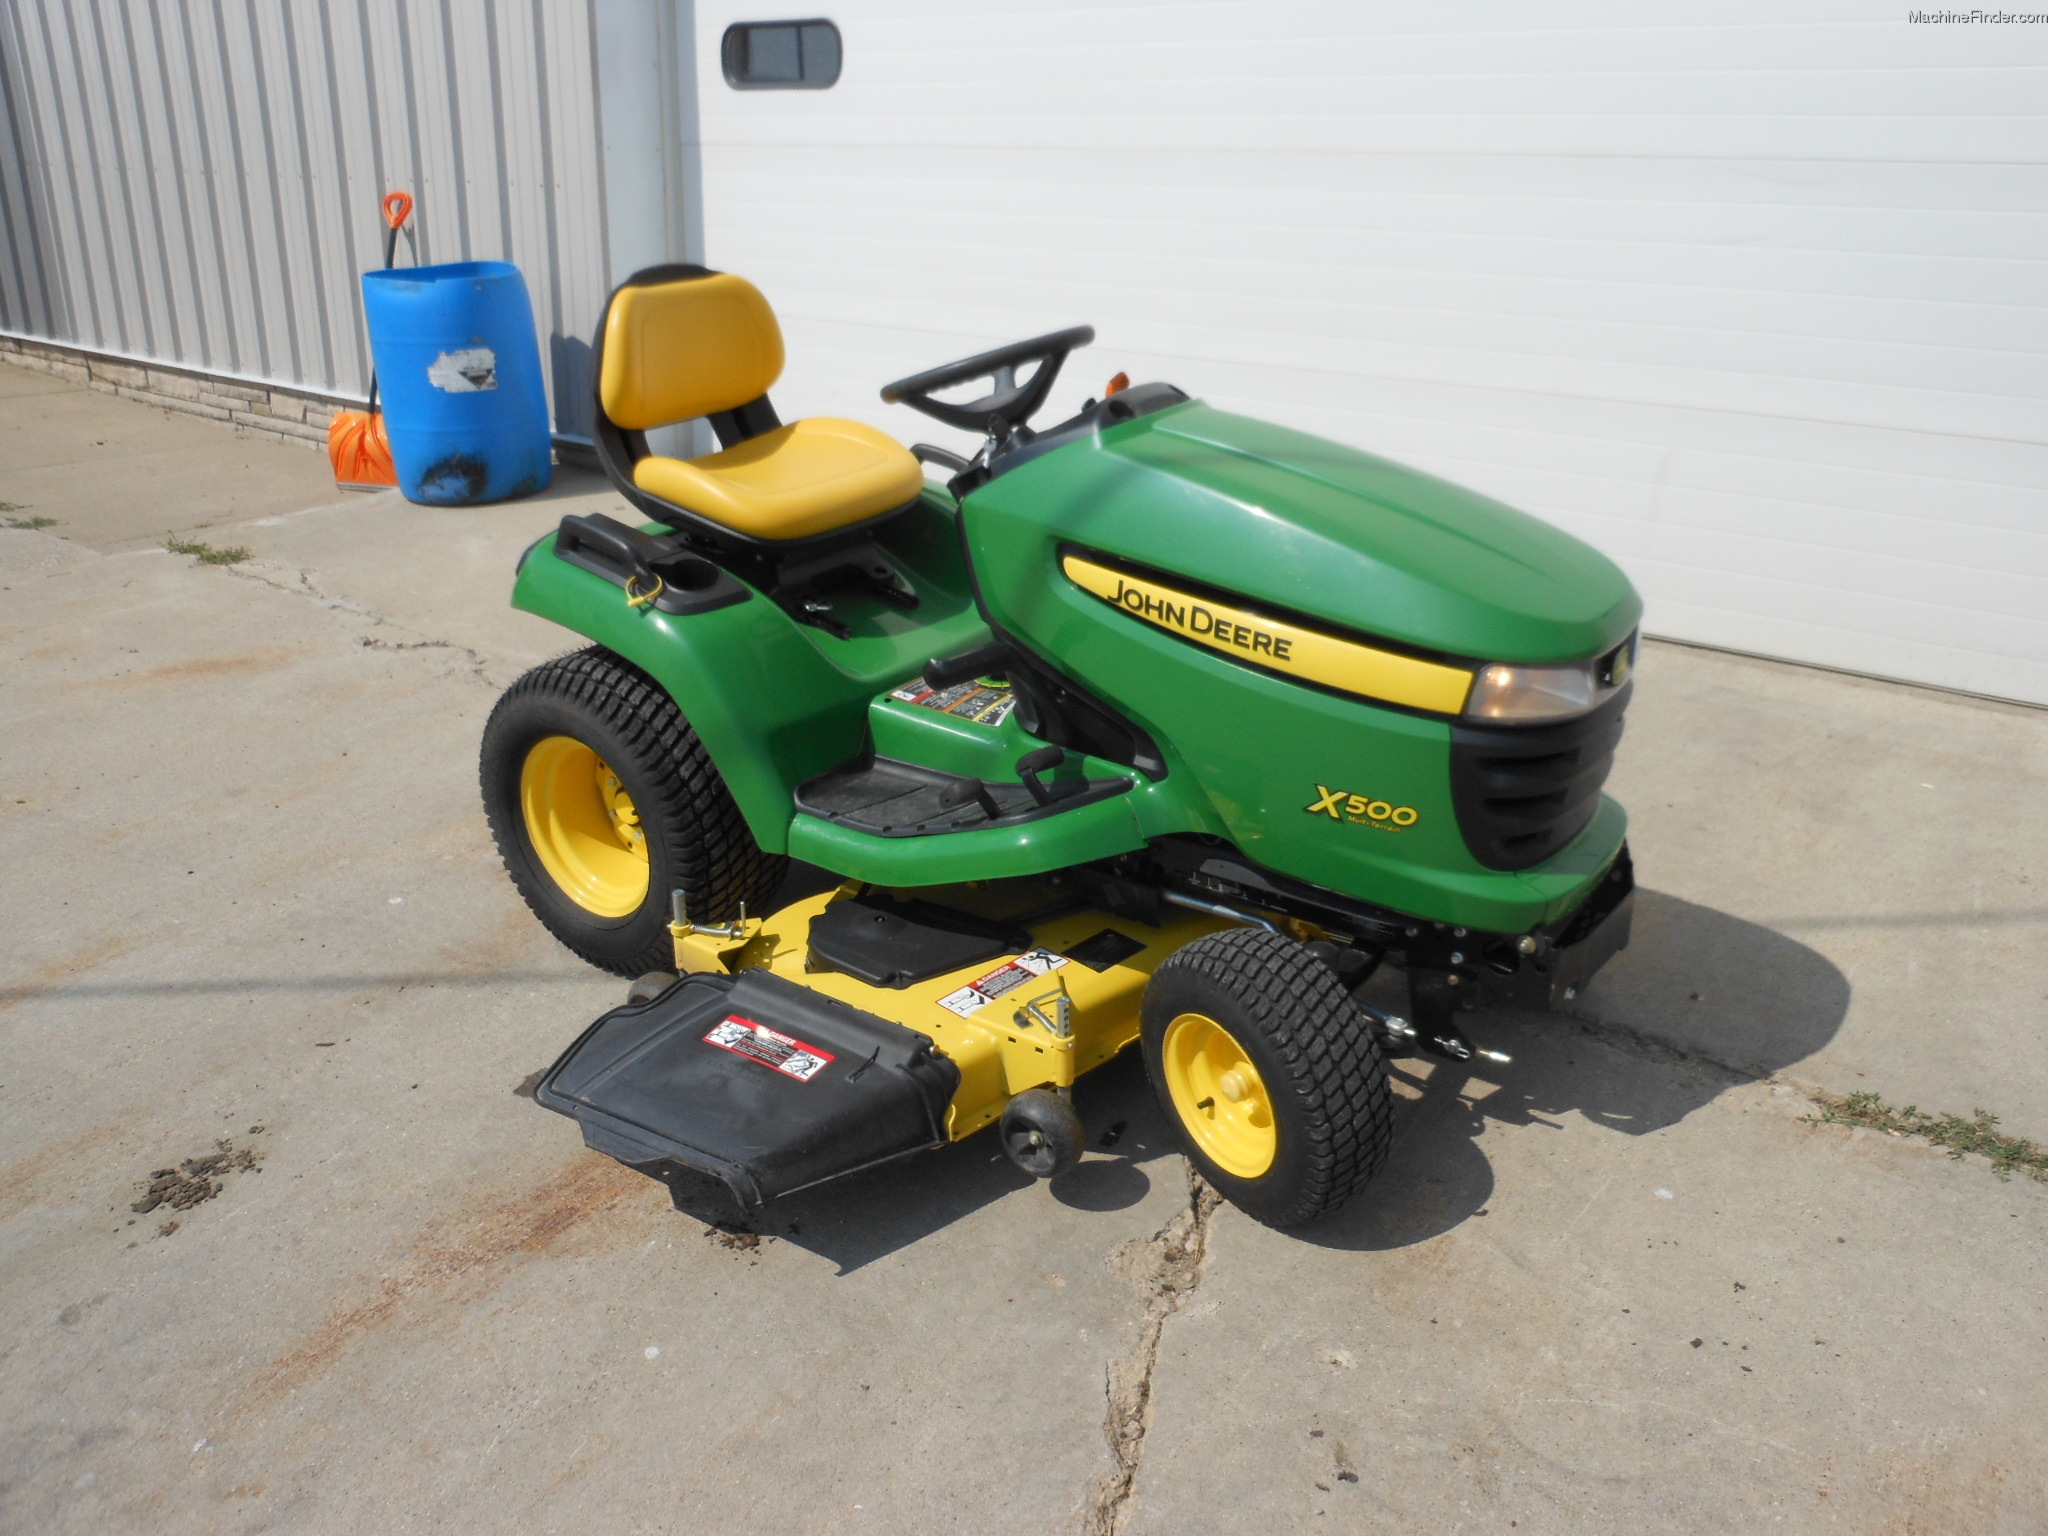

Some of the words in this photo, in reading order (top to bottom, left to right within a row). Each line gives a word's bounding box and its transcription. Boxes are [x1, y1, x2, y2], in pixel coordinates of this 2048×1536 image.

[1107, 580, 1185, 628] JOHN
[1190, 606, 1292, 661] DEERE
[1304, 784, 1418, 826] X500
[1347, 815, 1401, 833] Multi-Terrain
[982, 965, 1011, 981] DANGER
[770, 1031, 797, 1046] DANGER
